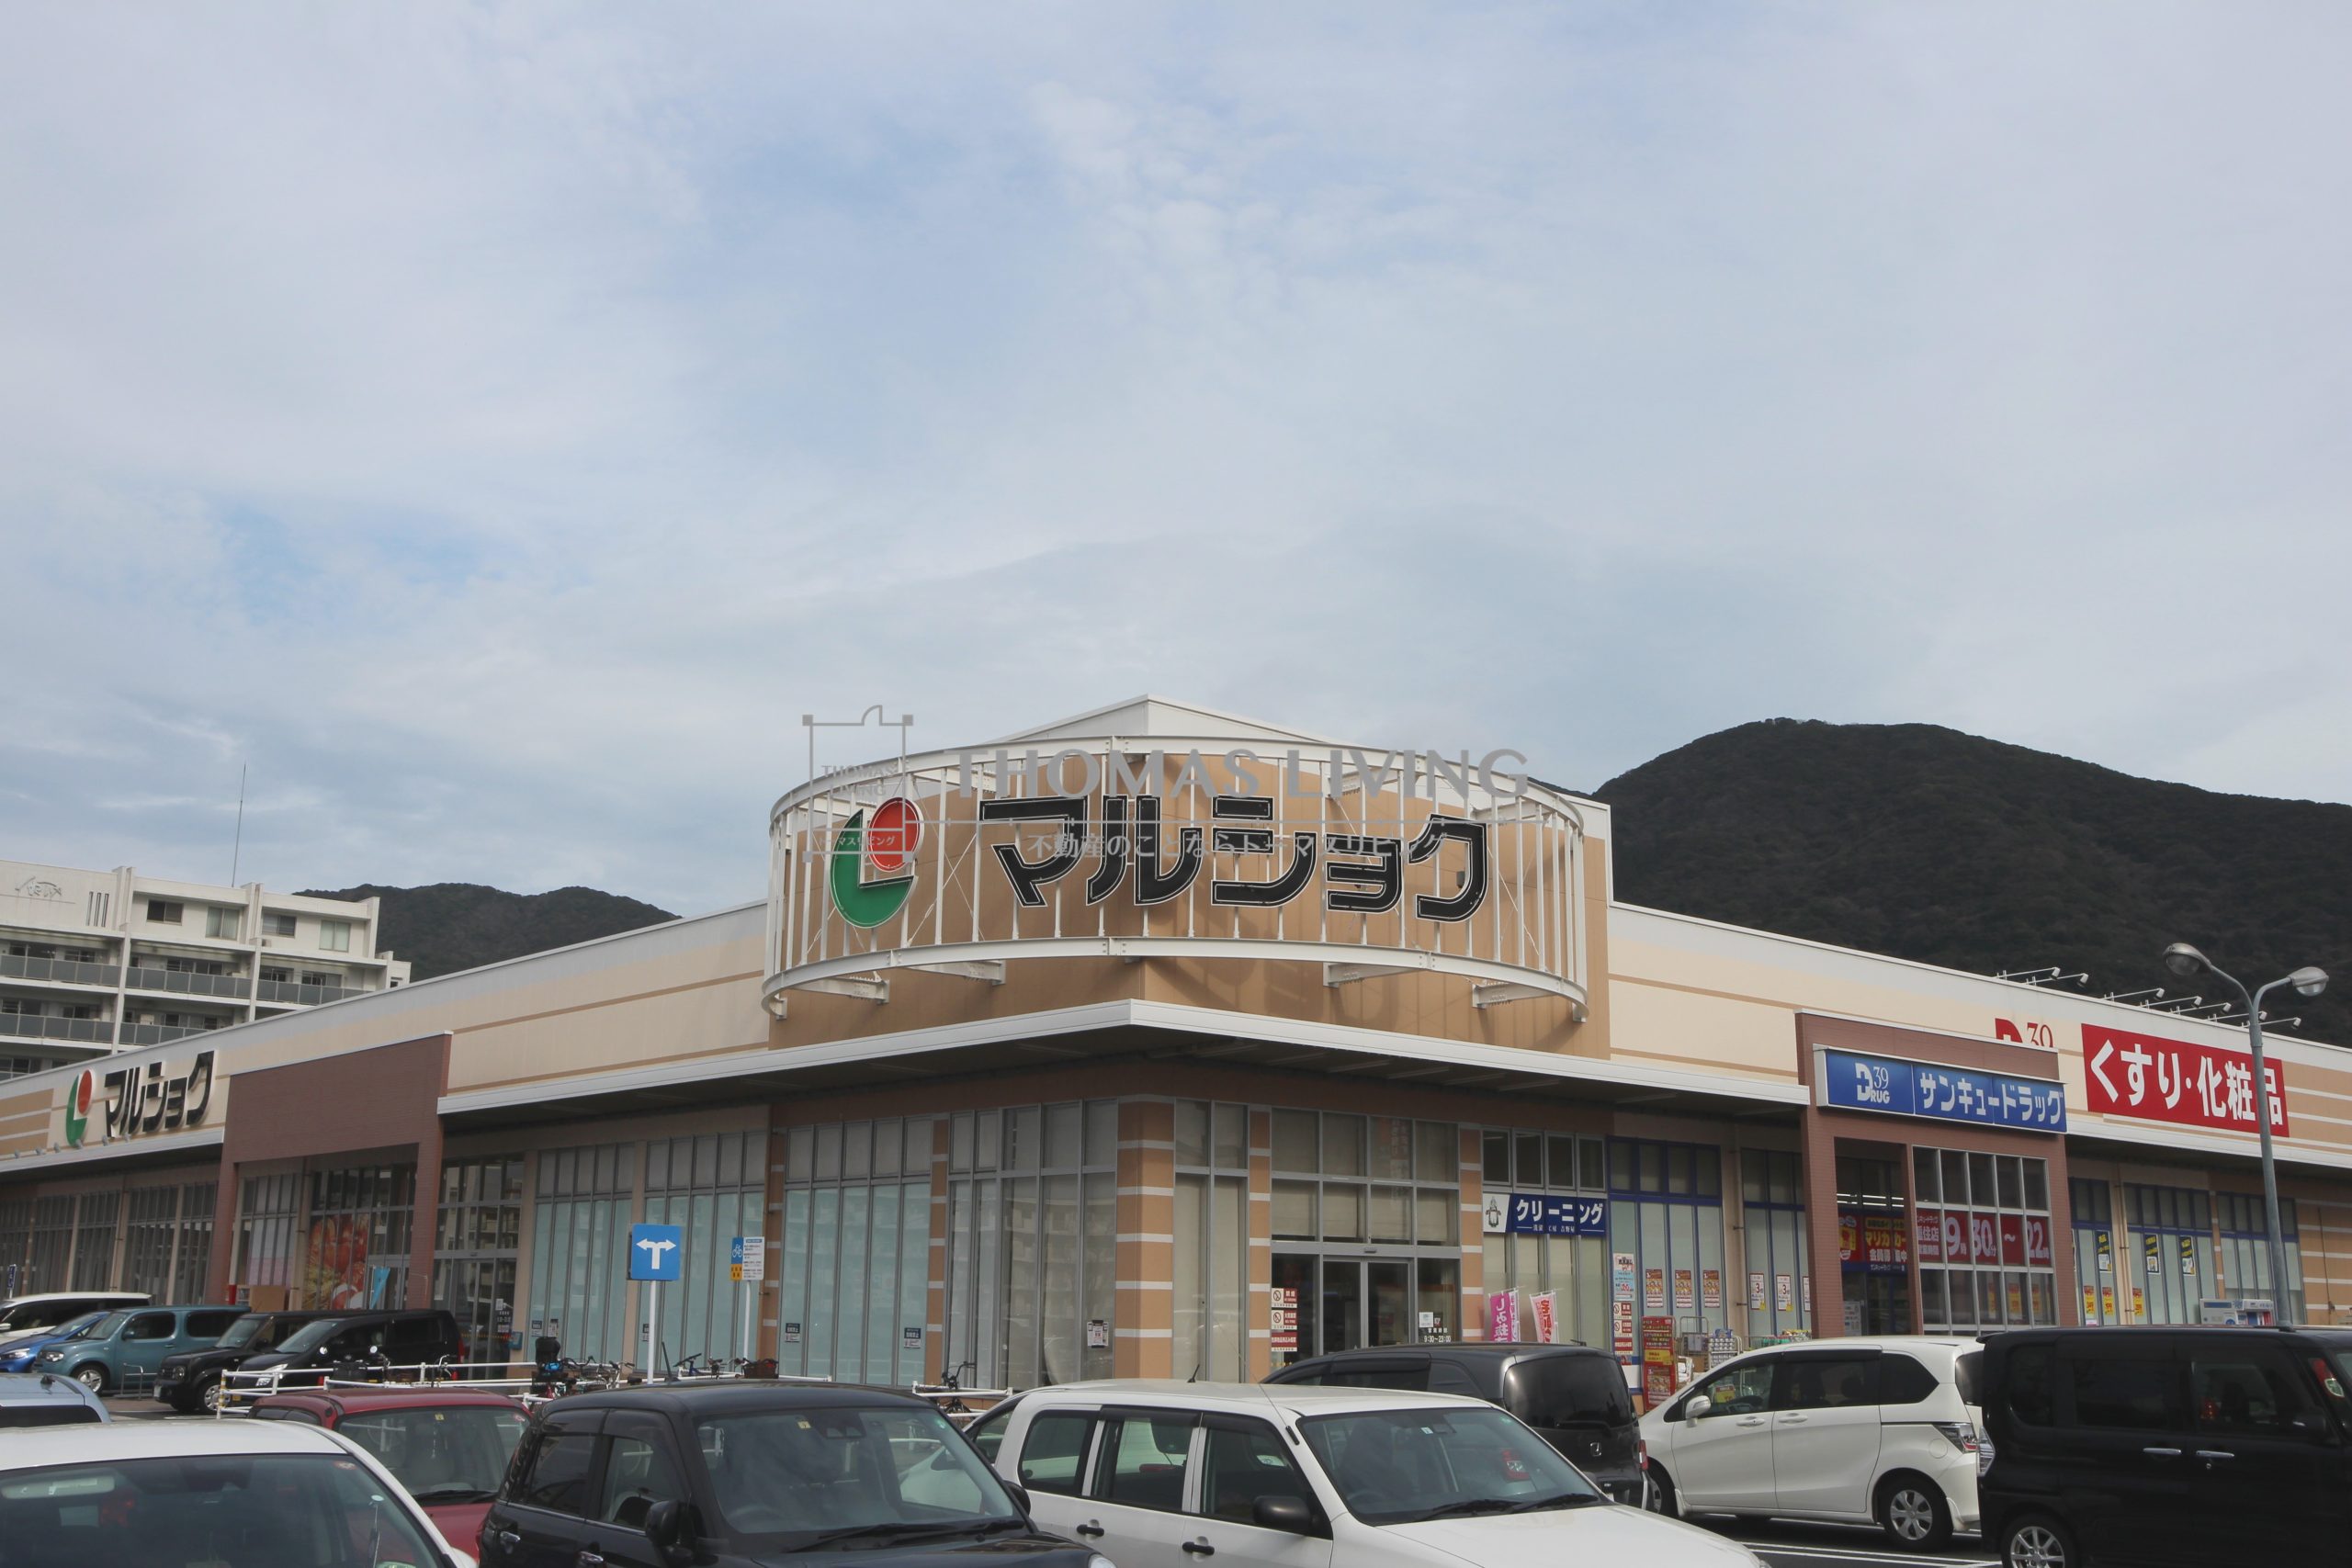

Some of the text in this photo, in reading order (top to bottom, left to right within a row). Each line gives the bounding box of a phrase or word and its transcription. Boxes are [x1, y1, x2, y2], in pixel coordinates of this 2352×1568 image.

[979, 793, 1488, 923] マルショク
[104, 1050, 215, 1139] マルショク
[1872, 1066, 1889, 1090] 39
[1919, 1072, 2064, 1125] サンキュードラッグ
[1516, 1199, 1603, 1225] クリーニング
